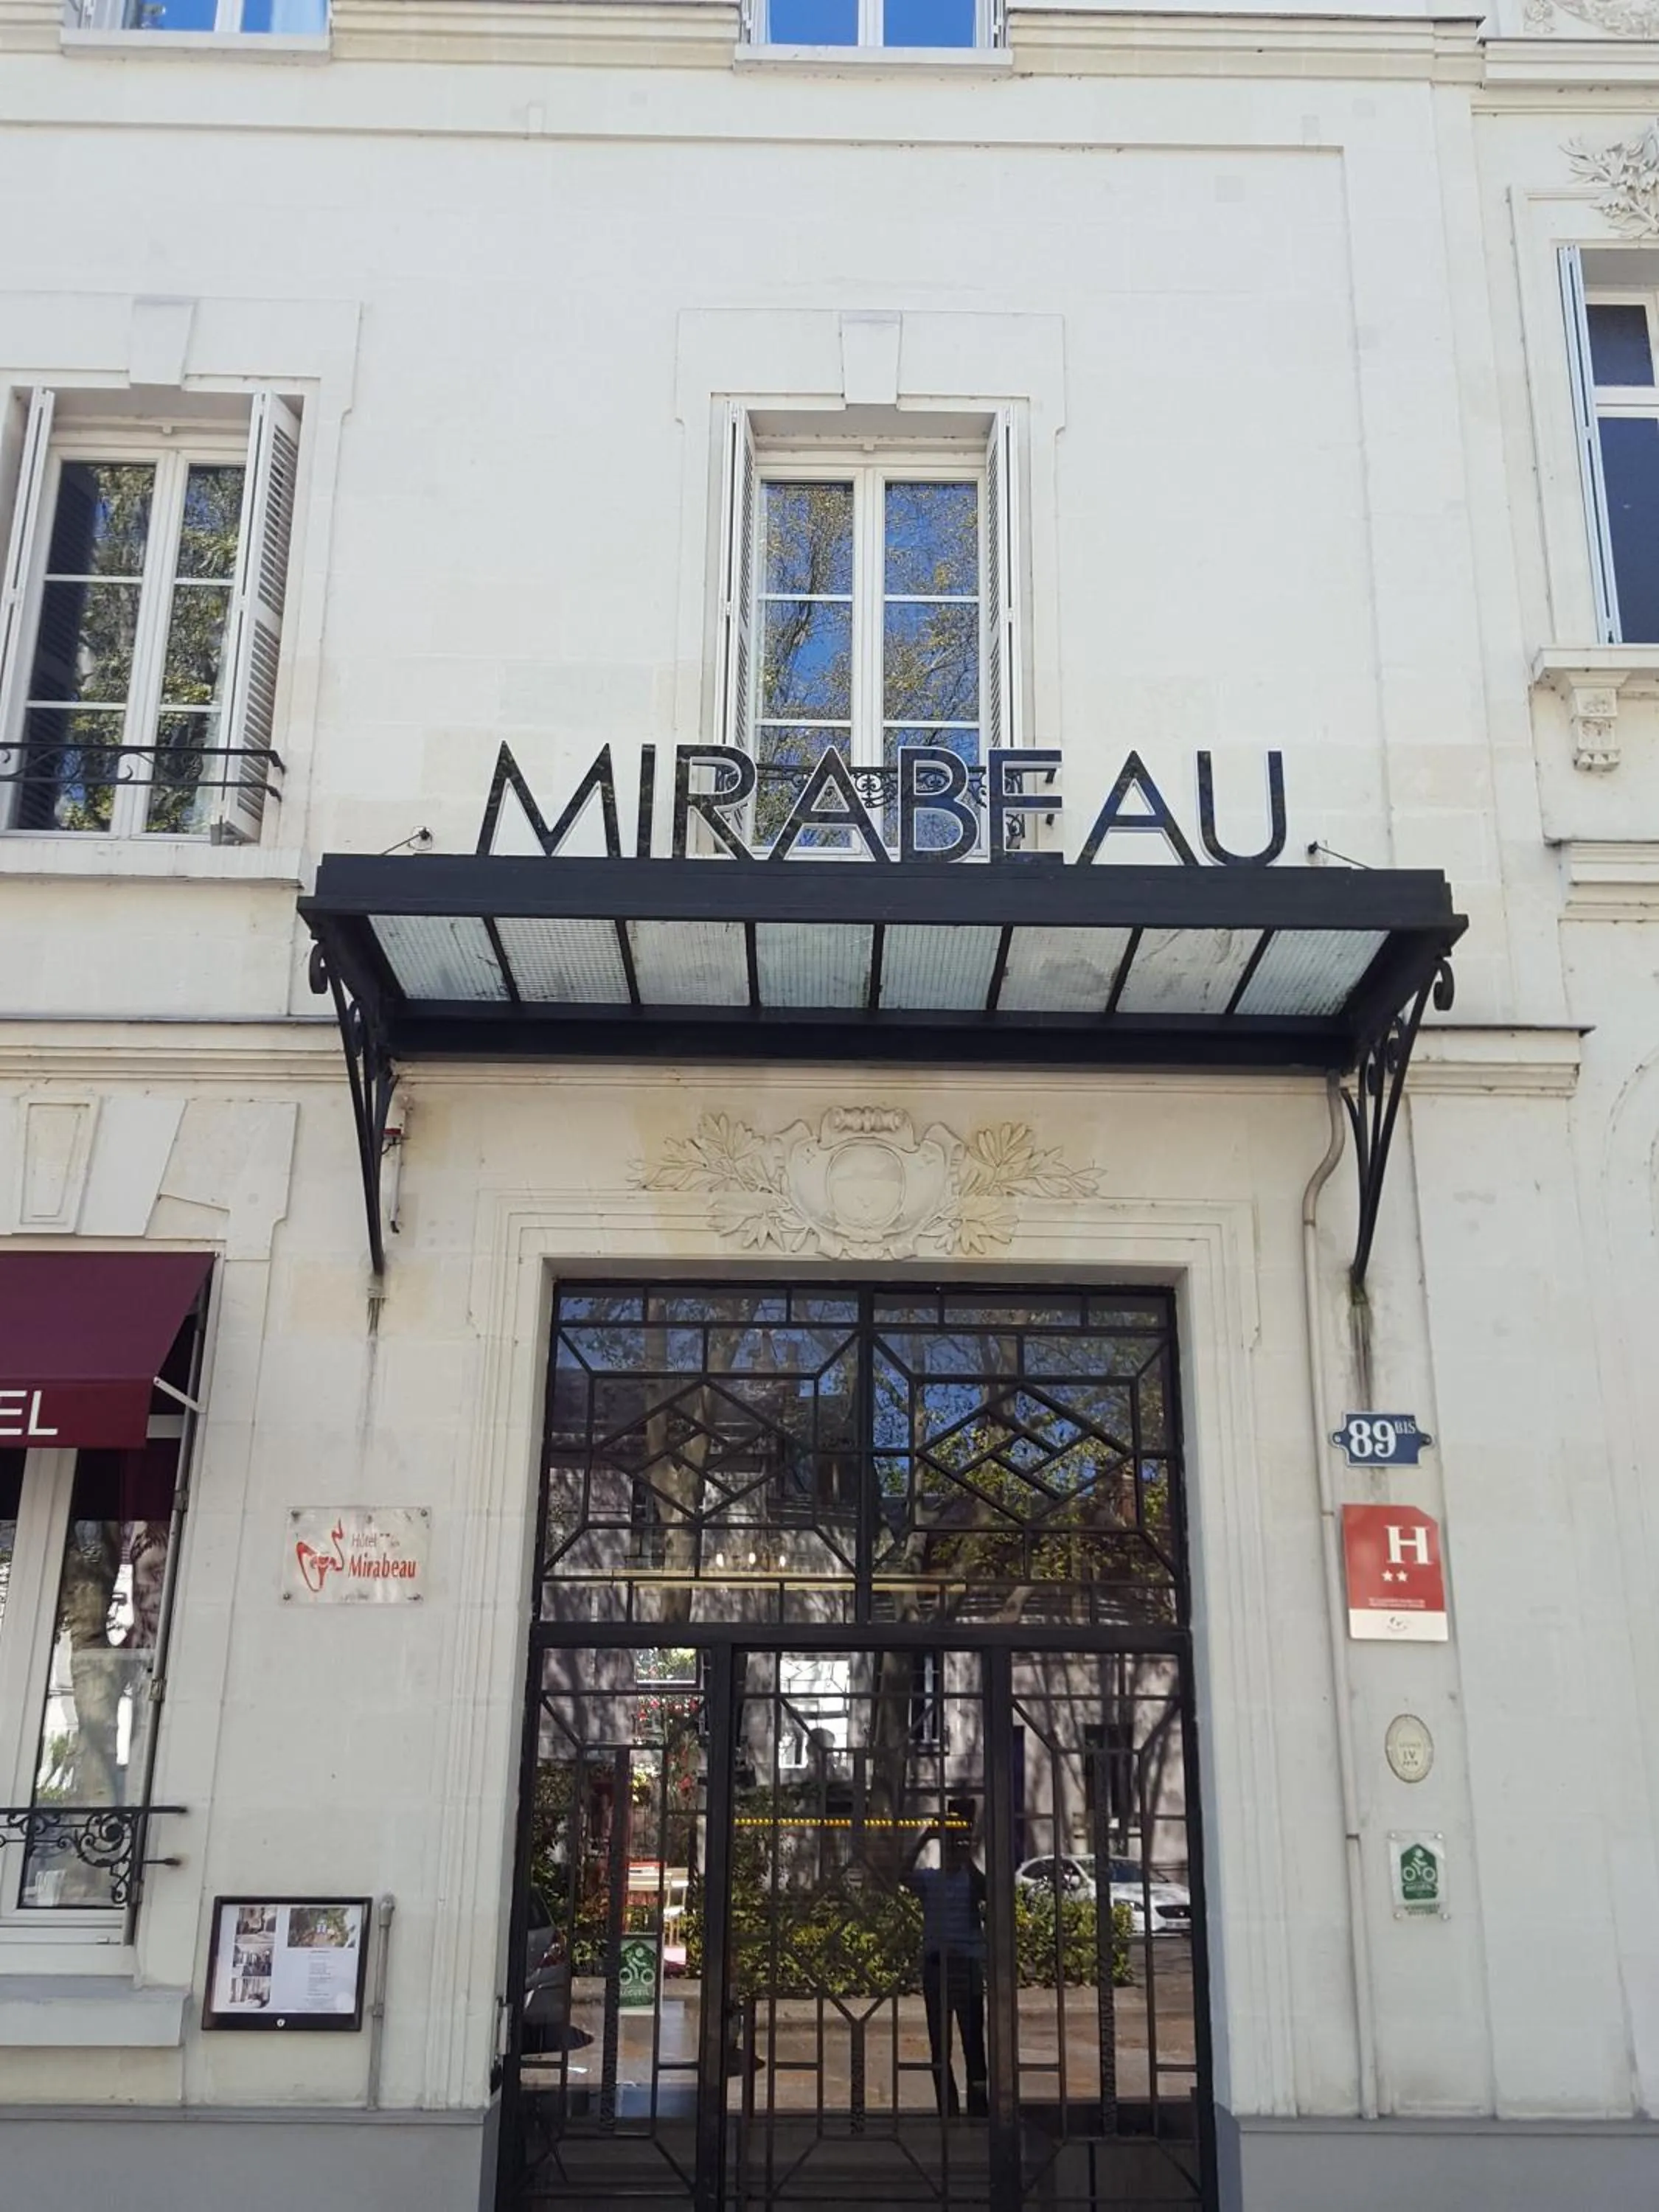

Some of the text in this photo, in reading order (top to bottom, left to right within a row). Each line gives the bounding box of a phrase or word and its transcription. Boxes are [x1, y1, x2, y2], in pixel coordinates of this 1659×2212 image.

[476, 740, 1287, 866] MIRABEAU
[1348, 1419, 1416, 1458] 89 BIS
[1384, 1525, 1433, 1565] H
[348, 1552, 417, 1578] Mirabeau
